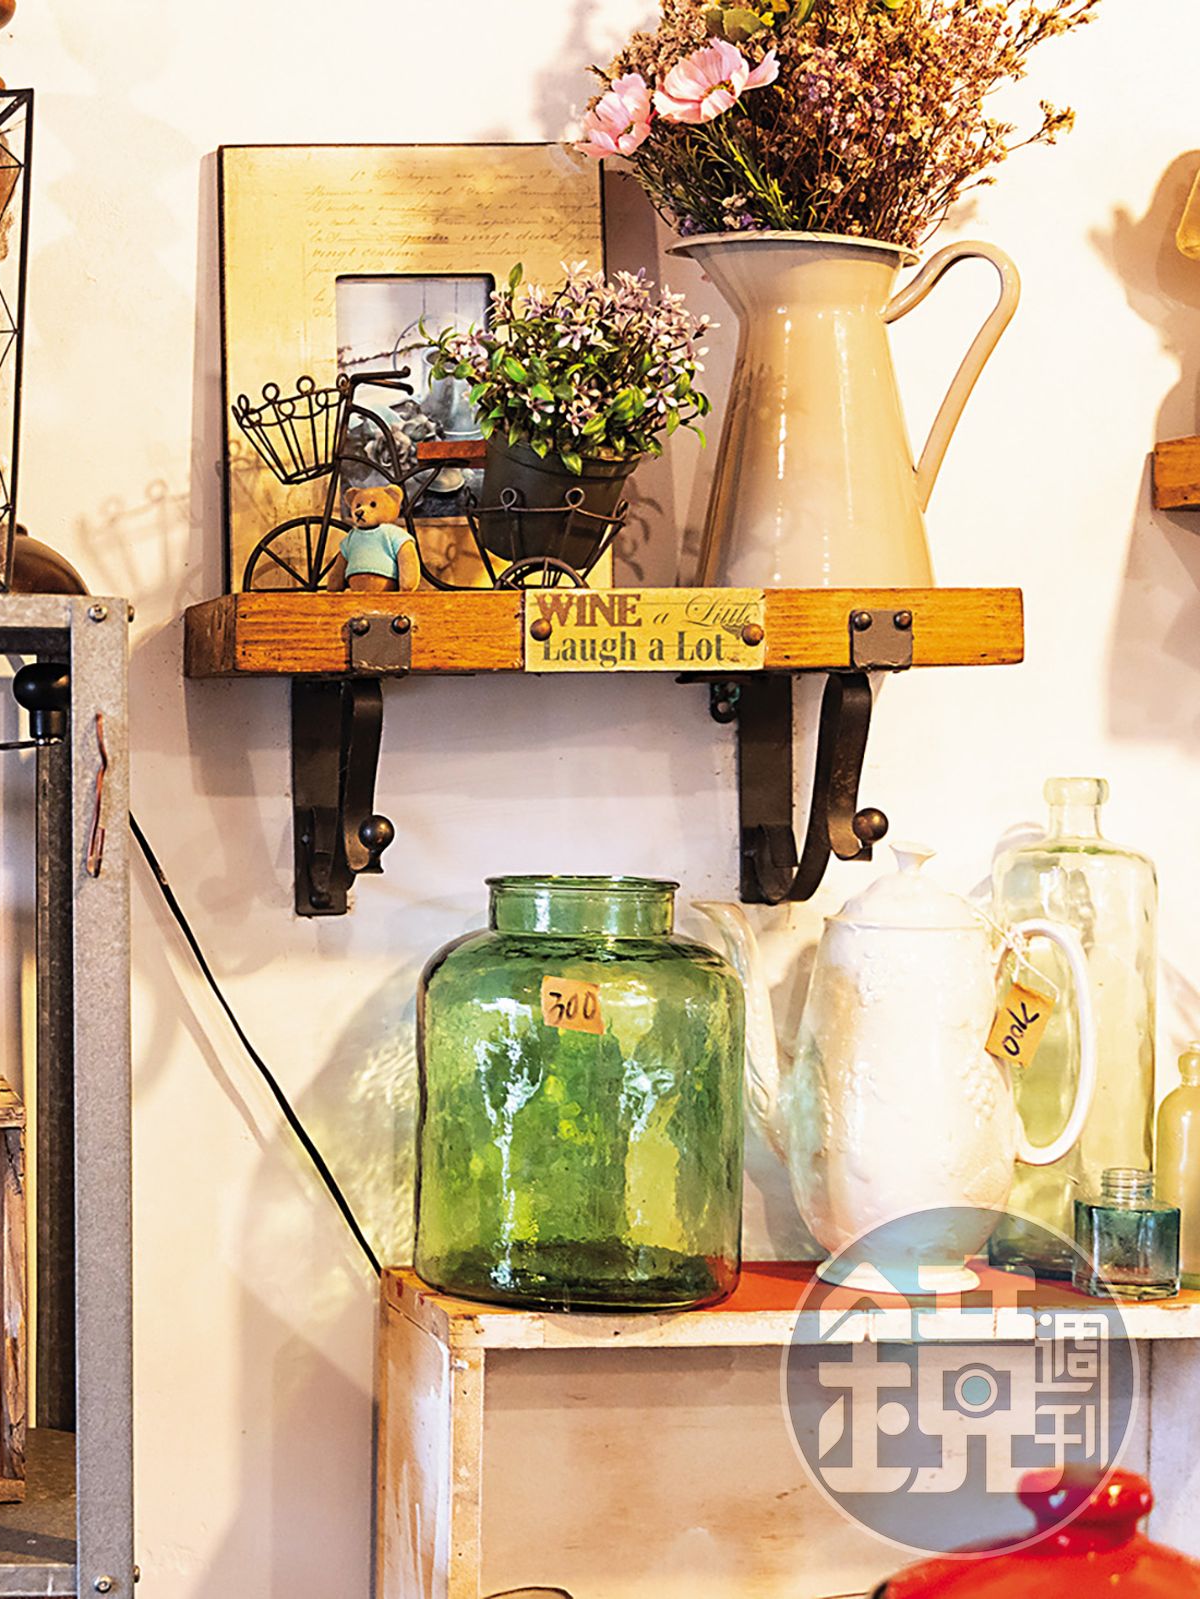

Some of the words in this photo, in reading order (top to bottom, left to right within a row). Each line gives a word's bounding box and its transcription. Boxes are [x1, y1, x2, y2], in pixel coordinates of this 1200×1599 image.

[533, 593, 642, 627] WINE
[652, 612, 670, 625] a
[542, 631, 637, 667] Laugh
[649, 638, 665, 661] a
[676, 631, 725, 661] Lot
[549, 991, 597, 1025] 300
